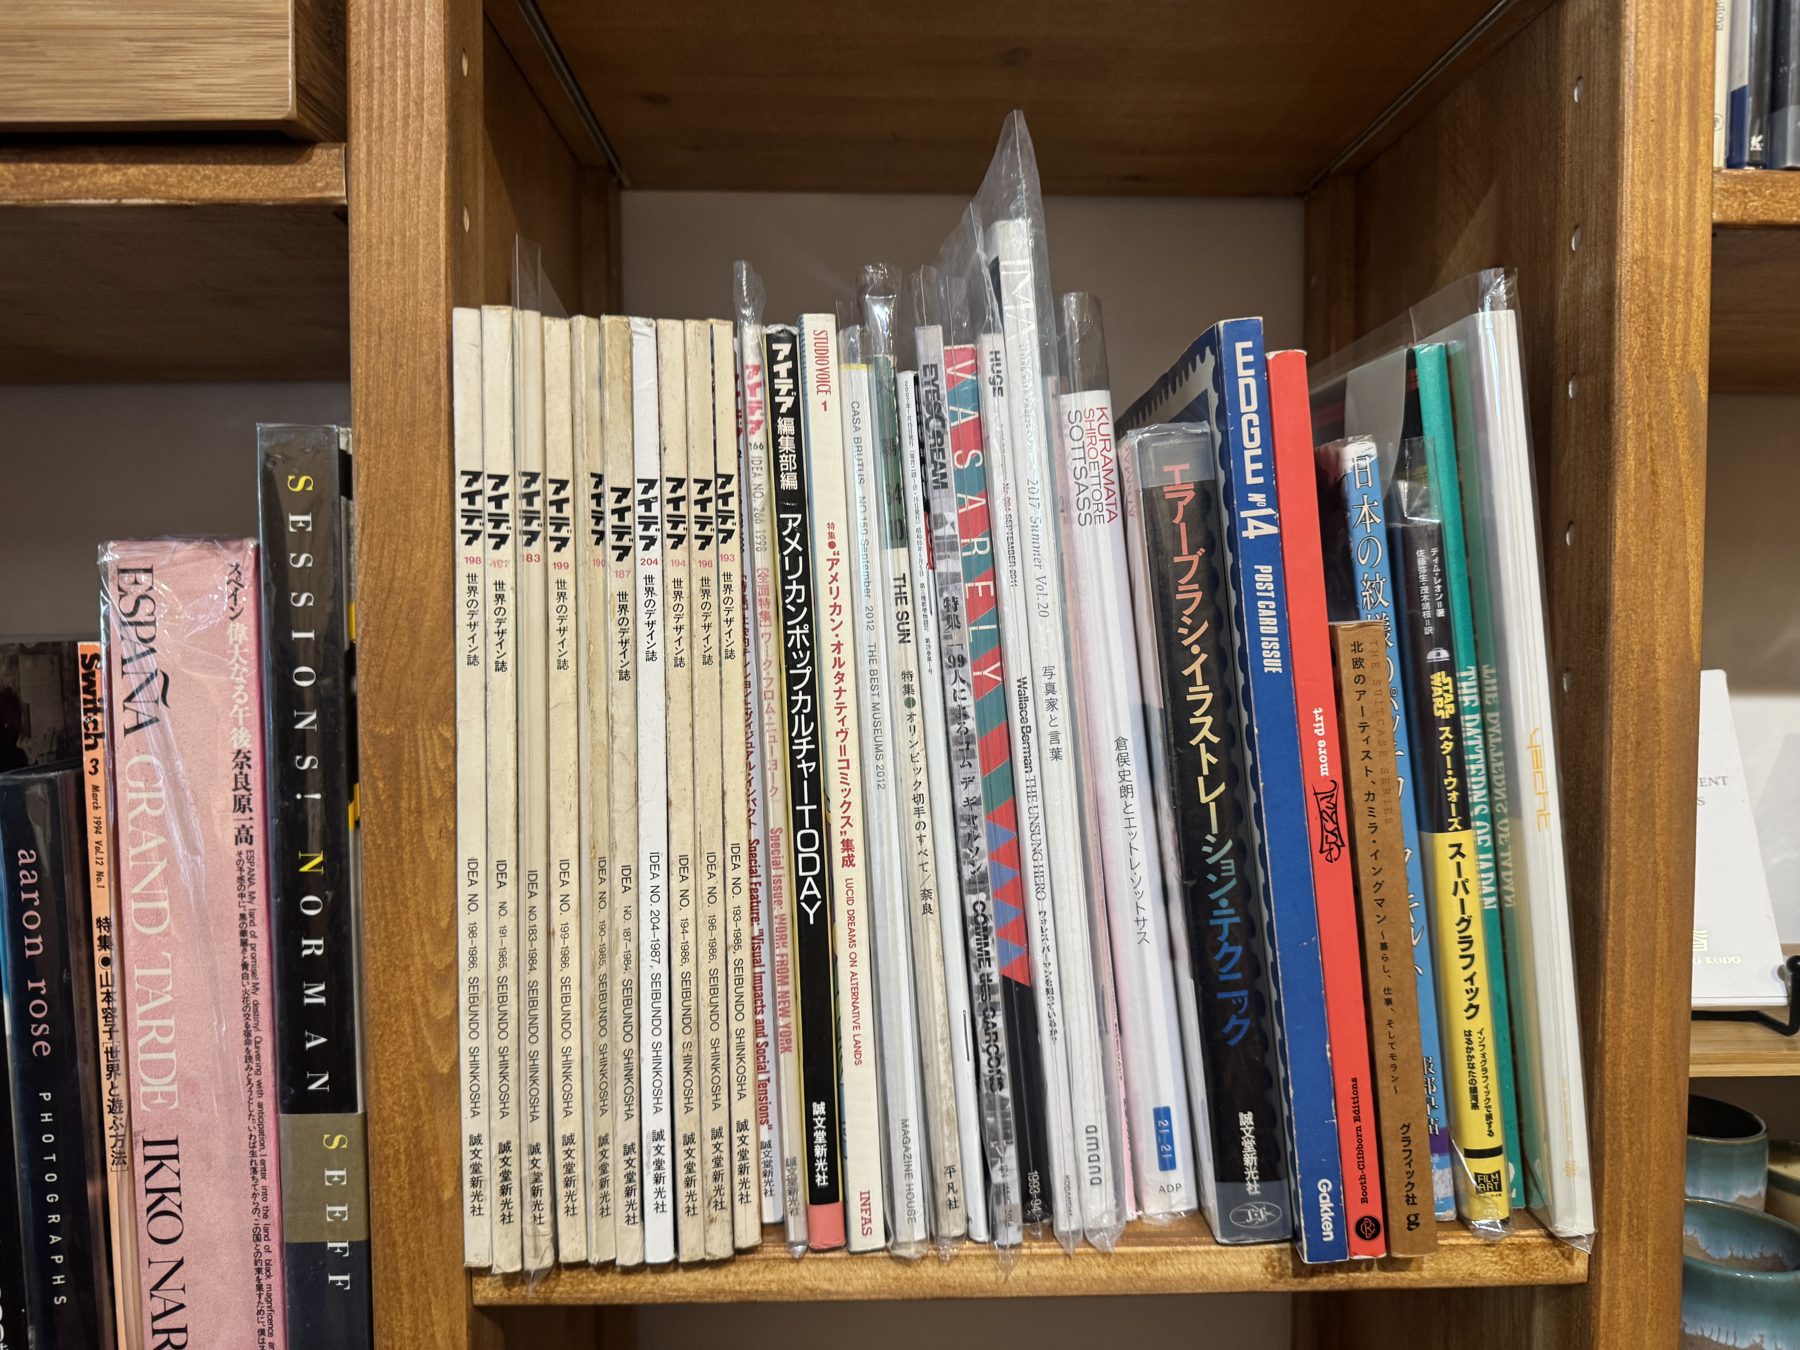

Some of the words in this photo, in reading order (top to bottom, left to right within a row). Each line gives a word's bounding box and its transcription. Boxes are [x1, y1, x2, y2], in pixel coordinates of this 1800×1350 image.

[821, 400, 828, 412] 1
[1235, 341, 1265, 485] EDGE
[1027, 479, 1040, 509] 2017
[1096, 406, 1119, 523] KURAMATA
[461, 471, 484, 545] アイデア
[487, 474, 511, 550] アイデア
[548, 478, 572, 553] アイデア
[610, 487, 633, 561] アイデア
[637, 478, 661, 551] アイデア
[666, 477, 688, 550] アイデア
[693, 478, 714, 551] アイデア
[717, 474, 736, 544] アイデア
[464, 557, 481, 565] 198
[553, 562, 569, 570] 199
[614, 570, 631, 578] 187
[640, 558, 658, 566] 204
[671, 559, 686, 567] 194
[720, 553, 735, 562] 193
[1254, 565, 1275, 598] POST
[466, 573, 480, 667] 世界のデザイン誌
[643, 574, 657, 662] 世界のデザイン誌
[700, 576, 713, 666] 世界のデザイン誌
[722, 572, 736, 660] 世界のデザイン誌
[865, 606, 874, 631] 2012
[893, 573, 908, 607] THE
[1257, 600, 1278, 634] CARD
[116, 565, 172, 738] ESPAÑA
[287, 474, 322, 800] SESSIONS!
[493, 580, 508, 672] 世界のデザイン誌
[555, 579, 569, 671] 世界のデザイン誌
[617, 591, 631, 682] 世界のデザイン誌
[672, 578, 685, 668] 世界のデザイン誌
[868, 644, 877, 663] THE
[895, 611, 911, 644] SUN
[1260, 636, 1282, 673] ISSUE
[80, 653, 105, 752] Switch
[869, 670, 880, 696] BEST
[871, 702, 885, 762] MUSEUMS
[1313, 707, 1326, 737] dirt
[88, 758, 99, 776] 3
[875, 764, 886, 790] 2012
[1317, 740, 1329, 777] more
[1438, 726, 1463, 832] スター・ウォーズ
[91, 784, 101, 810] March
[230, 749, 255, 846] 奈良原一高
[122, 754, 172, 936] GRAND
[468, 858, 478, 887] IDEA
[496, 859, 507, 889] IDEA
[559, 859, 569, 887] IDEA
[598, 856, 607, 885] IDEA
[649, 852, 660, 880] IDEA
[678, 854, 689, 883] IDEA
[707, 852, 717, 880] IDEA
[731, 843, 741, 871] IDEA
[17, 849, 43, 958] aaron
[468, 893, 479, 915] NO.
[498, 901, 508, 919] NO.
[528, 870, 538, 899] IDEA
[560, 894, 570, 915] NO.
[598, 891, 607, 913] NO.
[621, 865, 632, 893] IDEA
[650, 886, 661, 907] NO.
[679, 889, 690, 910] NO.
[707, 886, 717, 908] NO.
[732, 878, 742, 899] NO.
[623, 905, 632, 923] NO.
[847, 909, 857, 948] DREAMS
[1448, 842, 1481, 1021] スーパーグラフィック
[298, 851, 330, 1093] NORMAN
[733, 958, 745, 1022] SEIBUNDO
[849, 951, 858, 968] ON
[26, 979, 51, 1058] rose
[468, 976, 479, 1040] SEIBUNDO
[497, 975, 508, 1040] SEIBUNDO
[528, 980, 538, 1045] SEIBUNDO
[561, 976, 572, 1040] SEIBUNDO
[599, 973, 607, 1038] SEIBUNDO
[623, 978, 633, 1043] SEIBUNDO
[651, 972, 662, 1036] SEIBUNDO
[681, 972, 692, 1035] SEIBUNDO
[708, 968, 720, 1031] SEIBUNDO
[850, 970, 861, 1031] ALTERNATIVE
[134, 952, 180, 1112] TARDE
[853, 1034, 862, 1066] LANDS
[469, 1046, 480, 1118] SHINKOSHA
[498, 1046, 510, 1119] SHINKOSHA
[529, 1050, 540, 1123] SHINKOSHA
[562, 1046, 573, 1118] SHINKOSHA
[599, 1043, 608, 1118] SHINKOSHA
[623, 1049, 634, 1122] SHINKOSHA
[652, 1042, 663, 1115] SHINKOSHA
[682, 1041, 694, 1115] SHINKOSHA
[710, 1038, 721, 1111] SHINKOSHA
[735, 1028, 747, 1101] SHINKOSHA
[1351, 1077, 1361, 1123] Editions
[469, 1133, 484, 1217] 誠文堂新光社
[562, 1133, 578, 1217] 誠文堂新光社
[598, 1132, 611, 1218] 誠文堂新光社
[652, 1129, 668, 1213] 誠文堂新光社
[683, 1132, 698, 1217] 誠文堂新光社
[711, 1126, 727, 1212] 誠文堂新光社
[736, 1119, 752, 1205] 誠文堂新光社
[812, 1101, 829, 1188] 誠文堂新光社
[38, 1091, 67, 1305] PHOTOGRAPHS
[141, 1134, 184, 1245] IKKO
[498, 1140, 514, 1225] 誠文堂新光社
[529, 1142, 544, 1225] 誠文堂新光社
[623, 1142, 638, 1225] 誠文堂新光社
[905, 1183, 917, 1224] HOUSE
[1158, 1183, 1182, 1194] ADP
[1317, 1178, 1335, 1242] Gakken
[1478, 1173, 1499, 1183] FILM
[323, 1134, 352, 1291] SEEFF
[859, 1190, 873, 1236] INFAS
